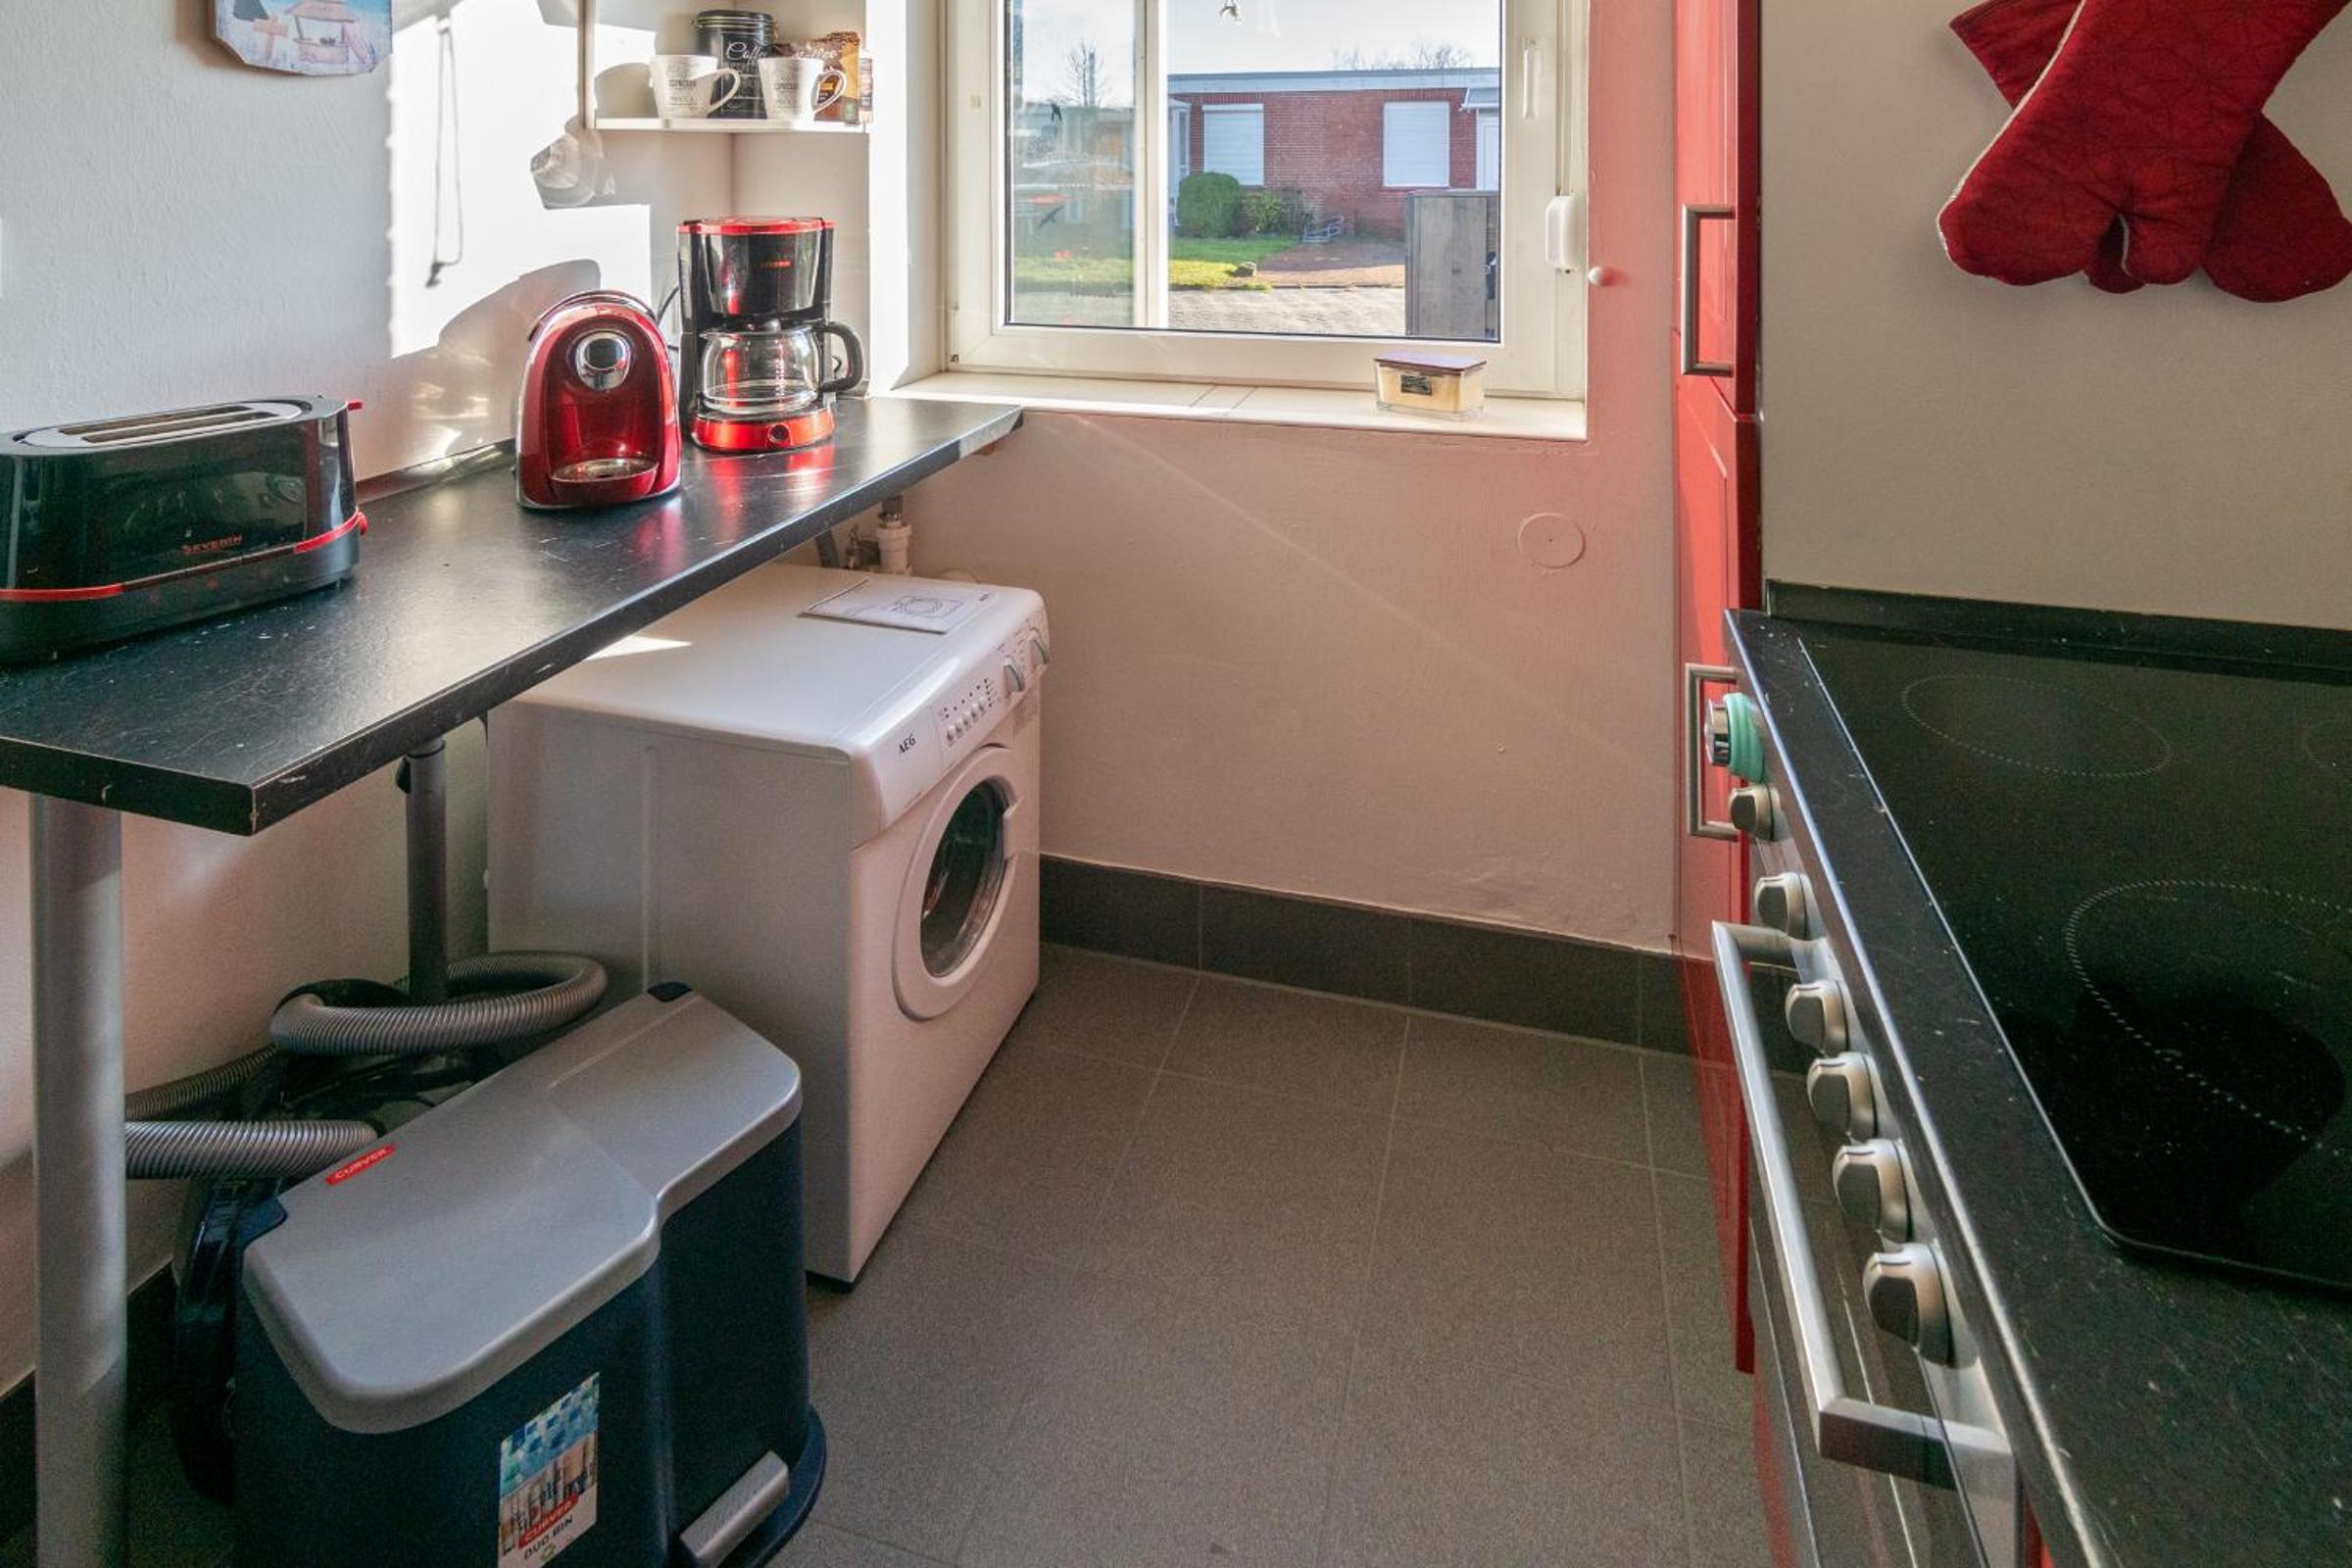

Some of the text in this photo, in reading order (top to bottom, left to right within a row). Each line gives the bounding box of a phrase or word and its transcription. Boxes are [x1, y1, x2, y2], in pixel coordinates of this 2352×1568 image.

[181, 534, 243, 556] SEVERIN
[899, 733, 917, 755] AEG
[334, 1147, 390, 1179] CURVER
[524, 1499, 573, 1542] CURVER
[524, 1515, 573, 1561] DUO BIN
